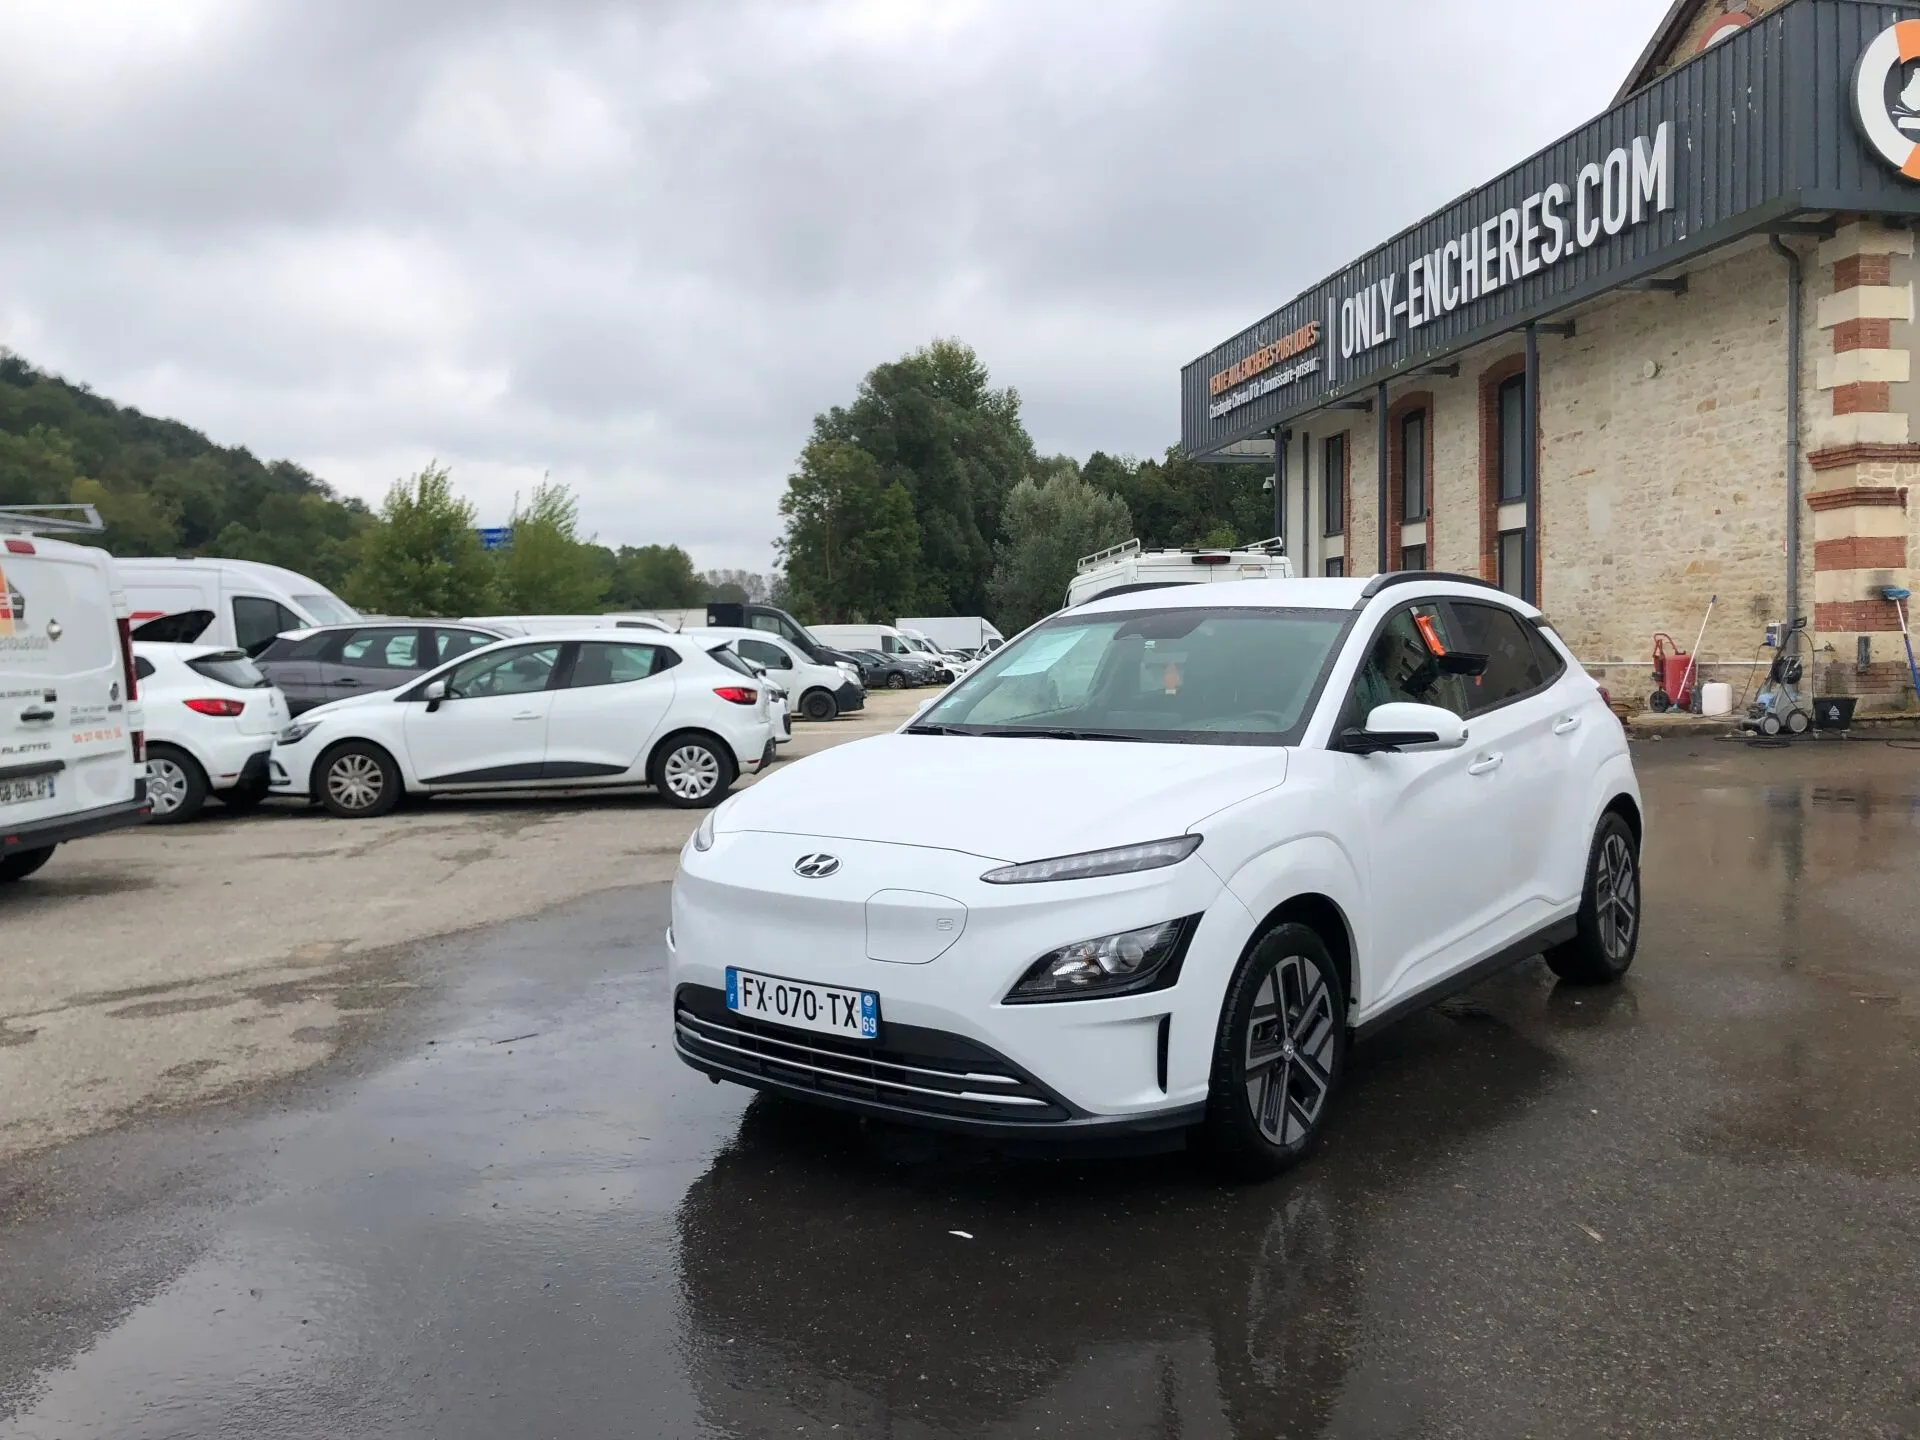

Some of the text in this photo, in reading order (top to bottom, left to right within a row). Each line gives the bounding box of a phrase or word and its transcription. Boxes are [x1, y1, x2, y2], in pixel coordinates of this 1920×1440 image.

[1341, 120, 1675, 359] ONLY-ENCHERES.COM
[1276, 320, 1319, 363] PUBLIQUES
[743, 976, 858, 1029] FX-070-TX
[862, 1016, 876, 1033] 69
